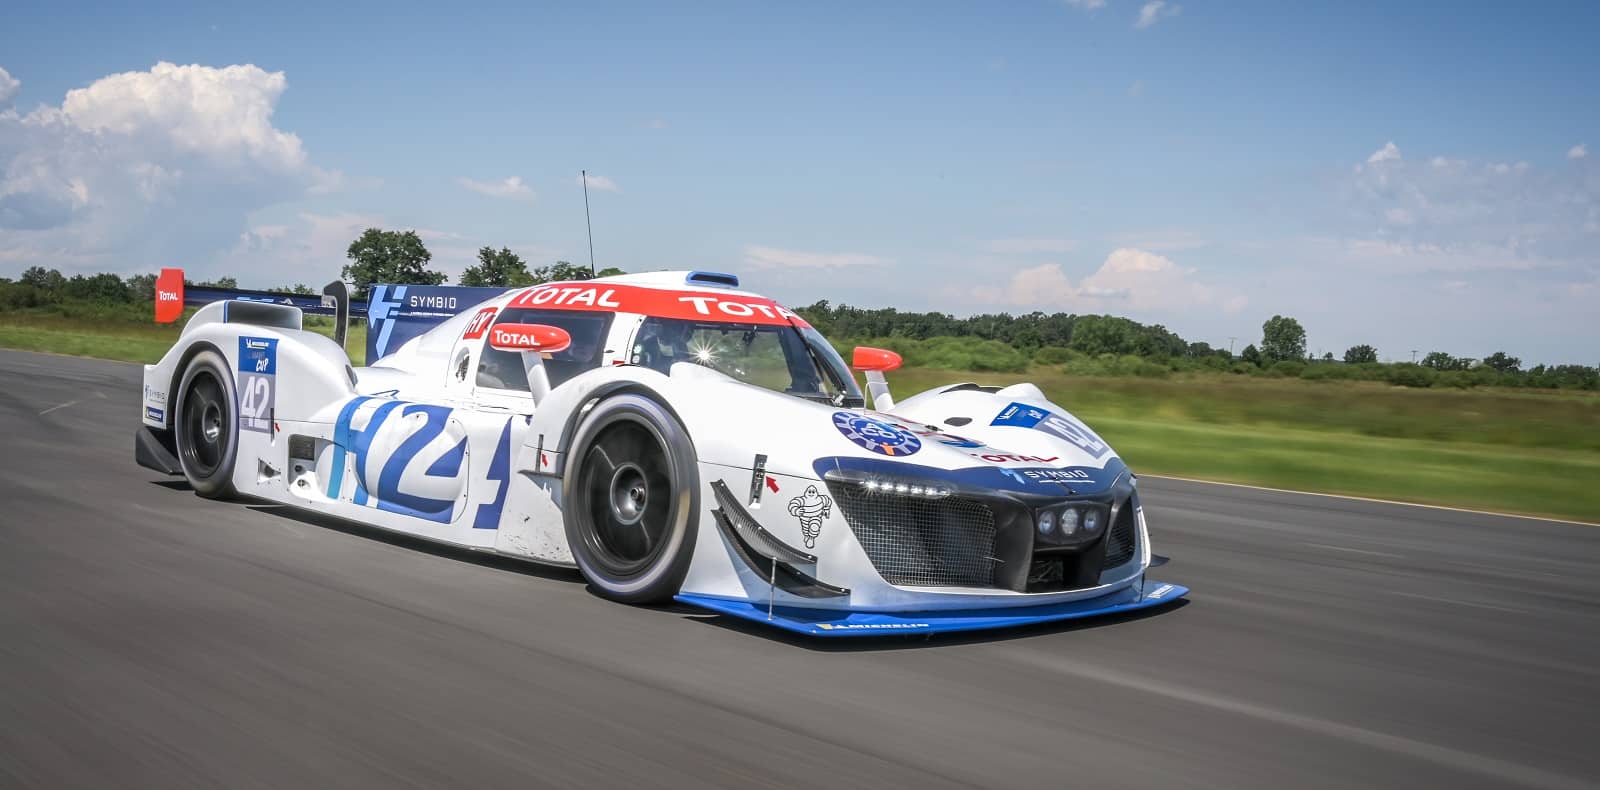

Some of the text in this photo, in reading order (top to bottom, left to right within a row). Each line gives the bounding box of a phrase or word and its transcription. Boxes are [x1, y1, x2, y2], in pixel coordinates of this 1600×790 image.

[159, 291, 178, 301] TOTAL
[410, 295, 457, 309] SYMBIO
[519, 286, 620, 308] TOTAL
[678, 296, 802, 321] TOTA
[494, 330, 541, 346] TOTAL
[241, 375, 270, 430] 42
[1043, 416, 1105, 452] 42
[970, 453, 1059, 463] OTAL
[1023, 469, 1090, 479] SYMBIO
